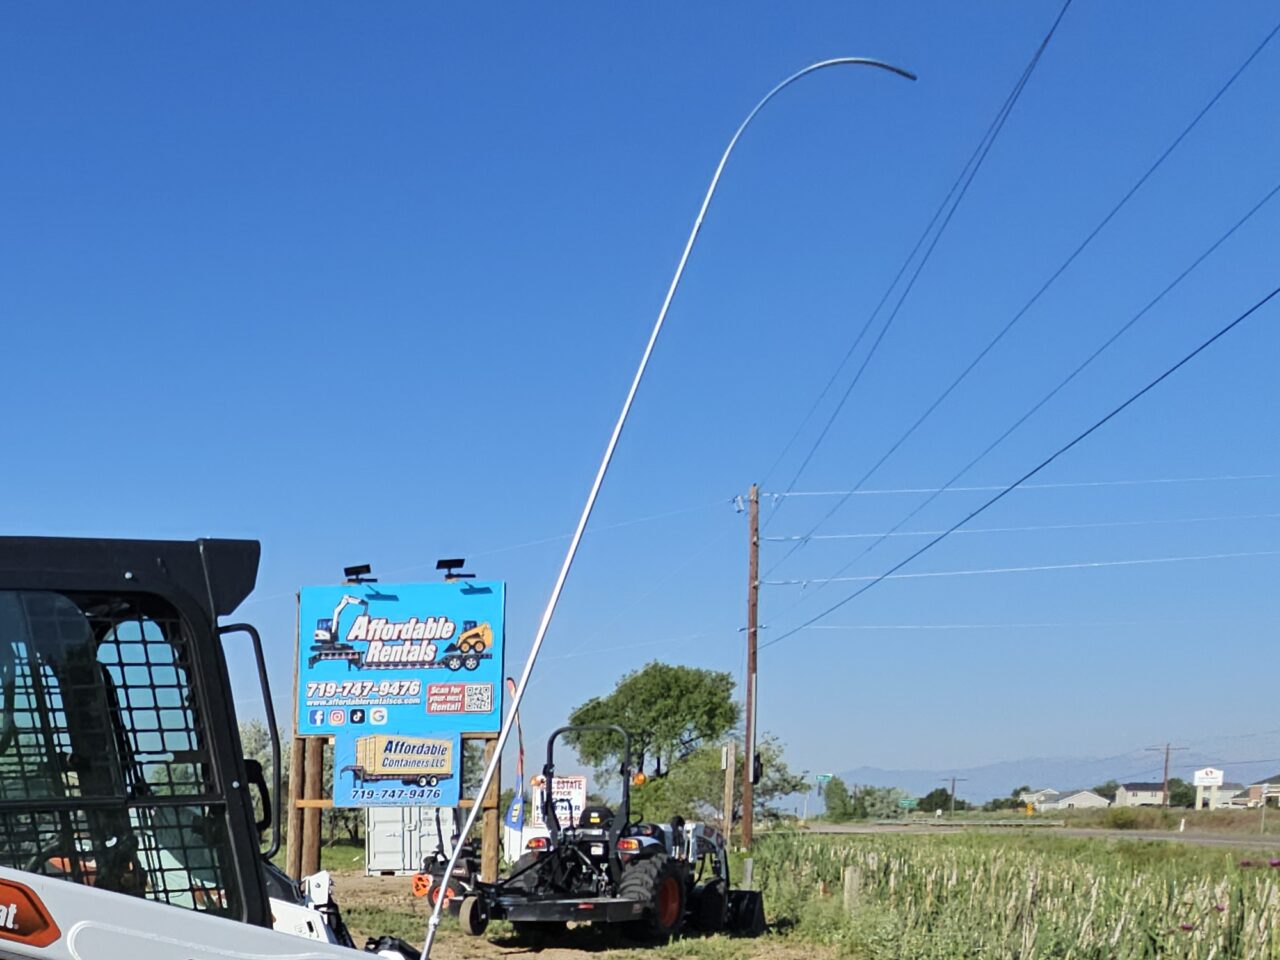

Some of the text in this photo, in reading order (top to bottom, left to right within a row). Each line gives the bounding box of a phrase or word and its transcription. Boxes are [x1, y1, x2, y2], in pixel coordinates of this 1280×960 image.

[346, 615, 455, 642] Affordable
[365, 641, 438, 664] Rentals
[307, 681, 421, 698] 719-747-9476
[430, 685, 462, 694] Scan for
[430, 702, 461, 712] Rental!
[383, 740, 448, 755] Affordable
[382, 757, 445, 767] Containers LLC
[352, 789, 441, 799] 719-747-9476
